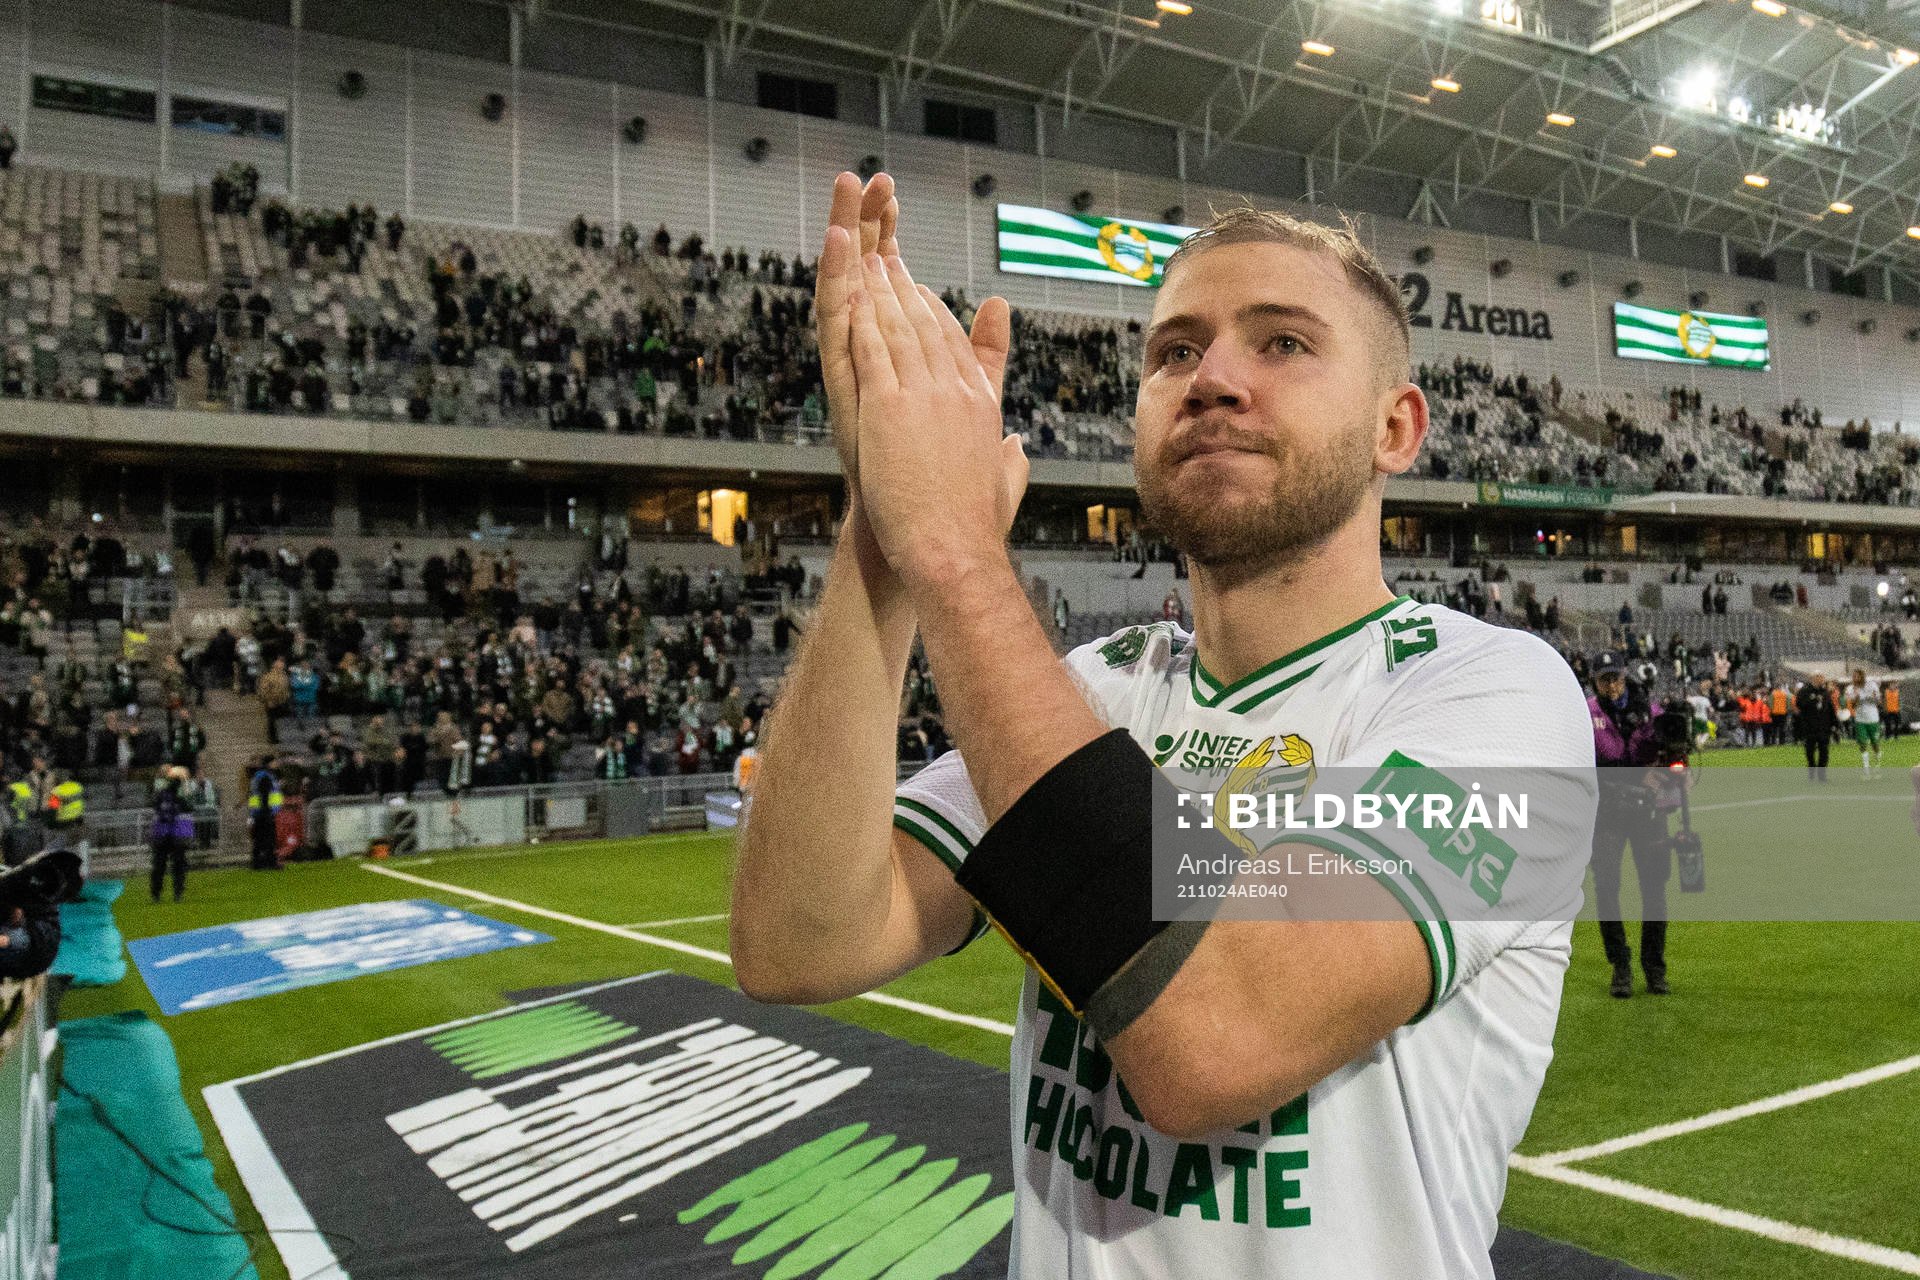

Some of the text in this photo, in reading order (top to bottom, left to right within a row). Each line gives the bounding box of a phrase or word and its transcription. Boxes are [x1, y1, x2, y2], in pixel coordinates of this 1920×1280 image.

[1399, 272, 1553, 340] 2 Arena
[1180, 751, 1239, 778] SPOR
[384, 1017, 873, 1253] UNIBET
